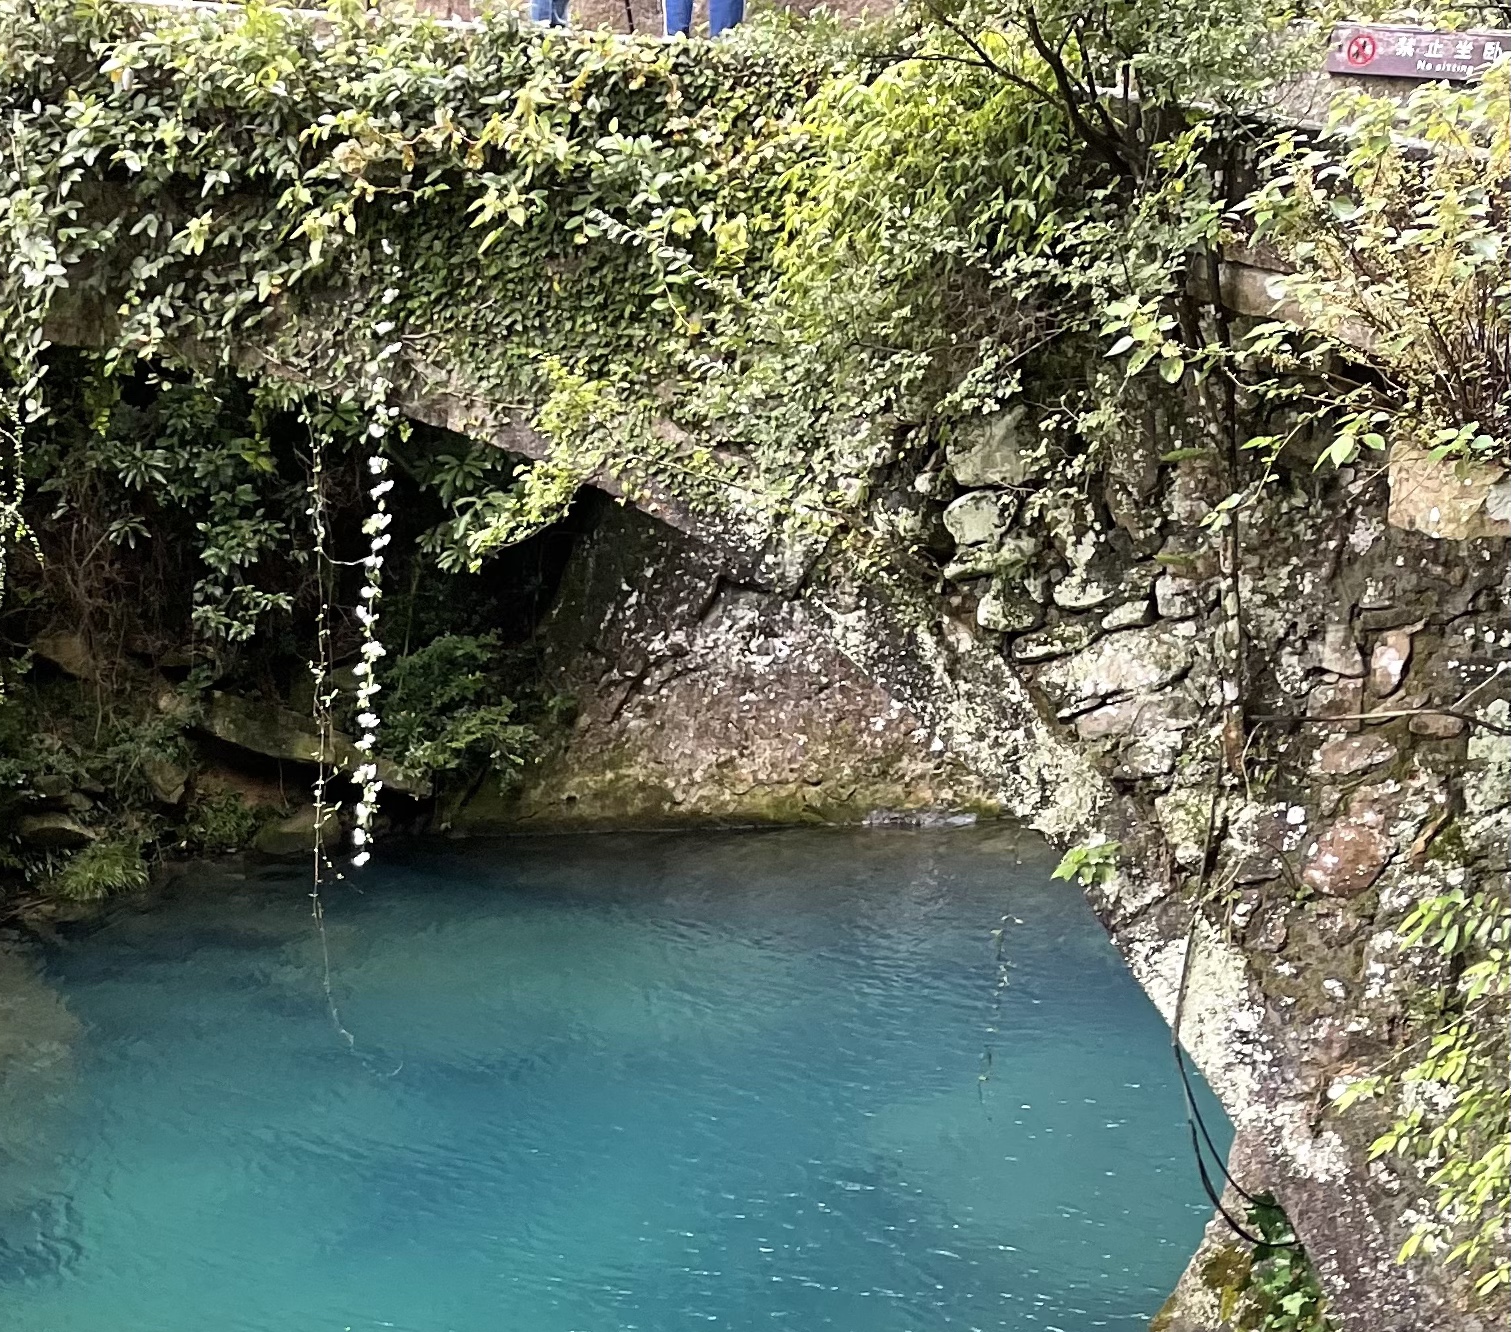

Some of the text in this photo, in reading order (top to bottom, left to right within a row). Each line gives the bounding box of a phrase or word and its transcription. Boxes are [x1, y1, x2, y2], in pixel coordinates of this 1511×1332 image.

[1395, 36, 1503, 60] 禁止坐卧
[1416, 60, 1474, 75] No sitting
